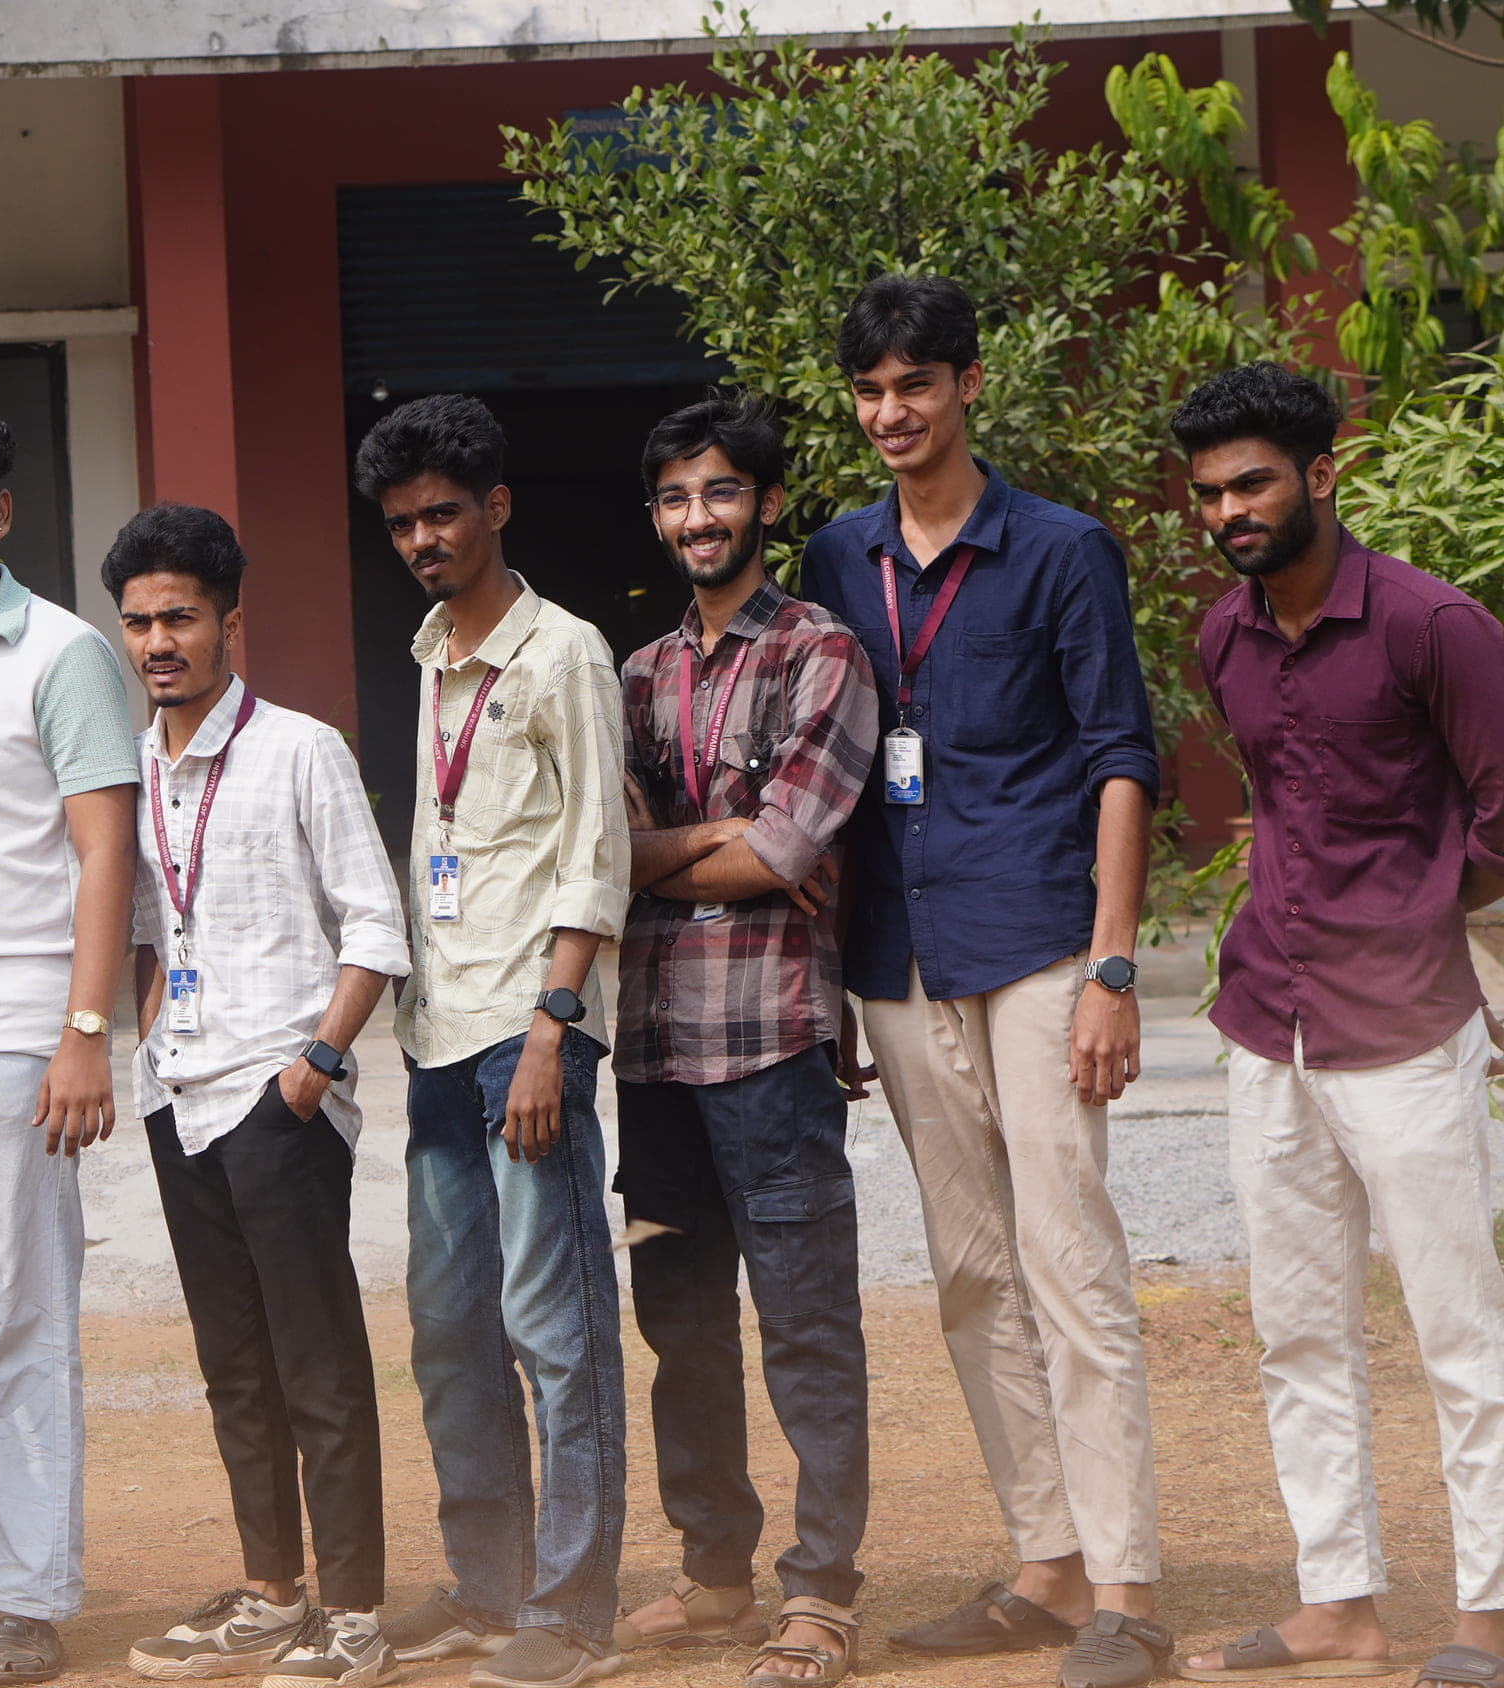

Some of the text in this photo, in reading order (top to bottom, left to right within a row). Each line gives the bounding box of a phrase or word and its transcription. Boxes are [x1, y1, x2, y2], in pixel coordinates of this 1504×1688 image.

[883, 556, 894, 609] TECHNOLOGY
[460, 672, 497, 749] SRINIVAS INSTITUTE
[706, 728, 720, 768] SRINIVAS
[203, 761, 221, 803] INSTITUTE
[153, 791, 164, 830] INSTITUTE
[200, 805, 208, 816] OF
[159, 834, 172, 869] SRINIVAS
[189, 818, 207, 873] TECHNOLOGY
